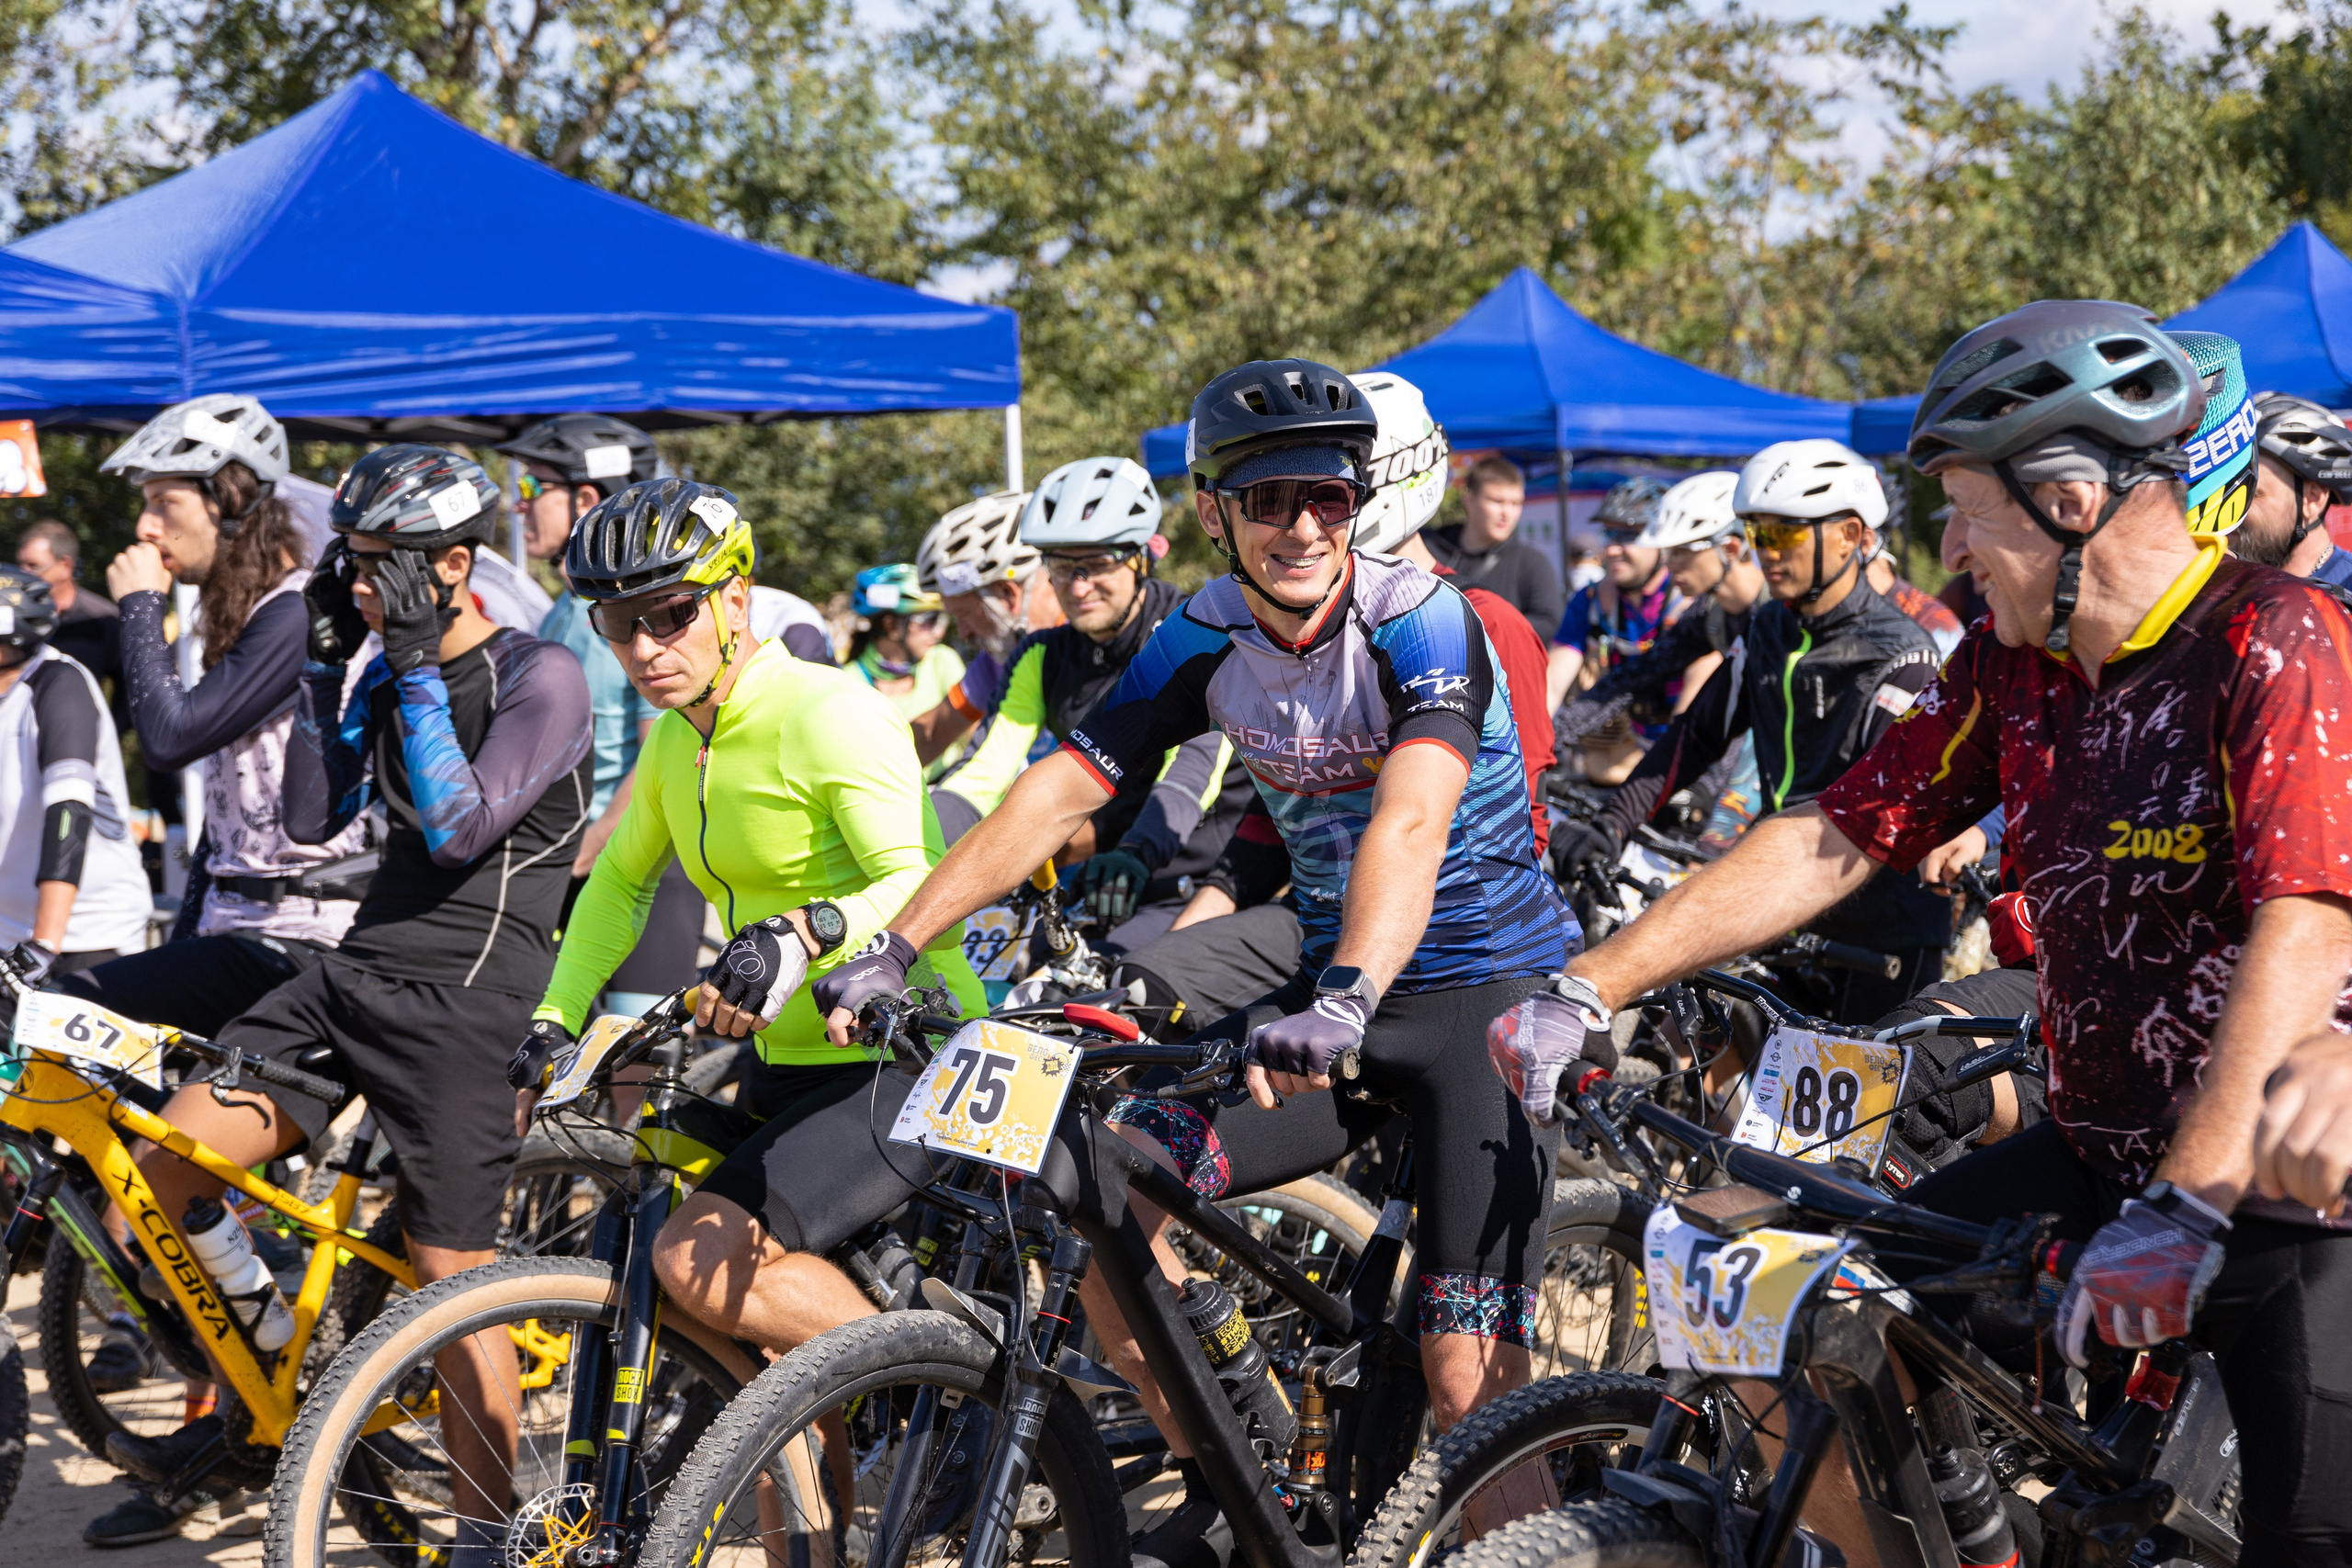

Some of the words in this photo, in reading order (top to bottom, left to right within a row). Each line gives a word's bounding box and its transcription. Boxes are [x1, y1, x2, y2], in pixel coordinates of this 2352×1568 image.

[1366, 423, 1449, 489] 100%
[447, 491, 465, 513] 67
[702, 499, 723, 519] 76
[1419, 480, 1439, 508] 187
[1408, 699, 1464, 712] TEAM
[1261, 760, 1355, 785] TEAM
[2102, 819, 2208, 863] 2008
[64, 1013, 121, 1050] 67
[1026, 1043, 1048, 1056] ВЕЛО
[1864, 1055, 1885, 1066] ВЕЛО
[938, 1047, 1016, 1124] 75
[1792, 1066, 1859, 1143] 88
[111, 1169, 232, 1341] X-COBRA
[1685, 1239, 1760, 1328] 53
